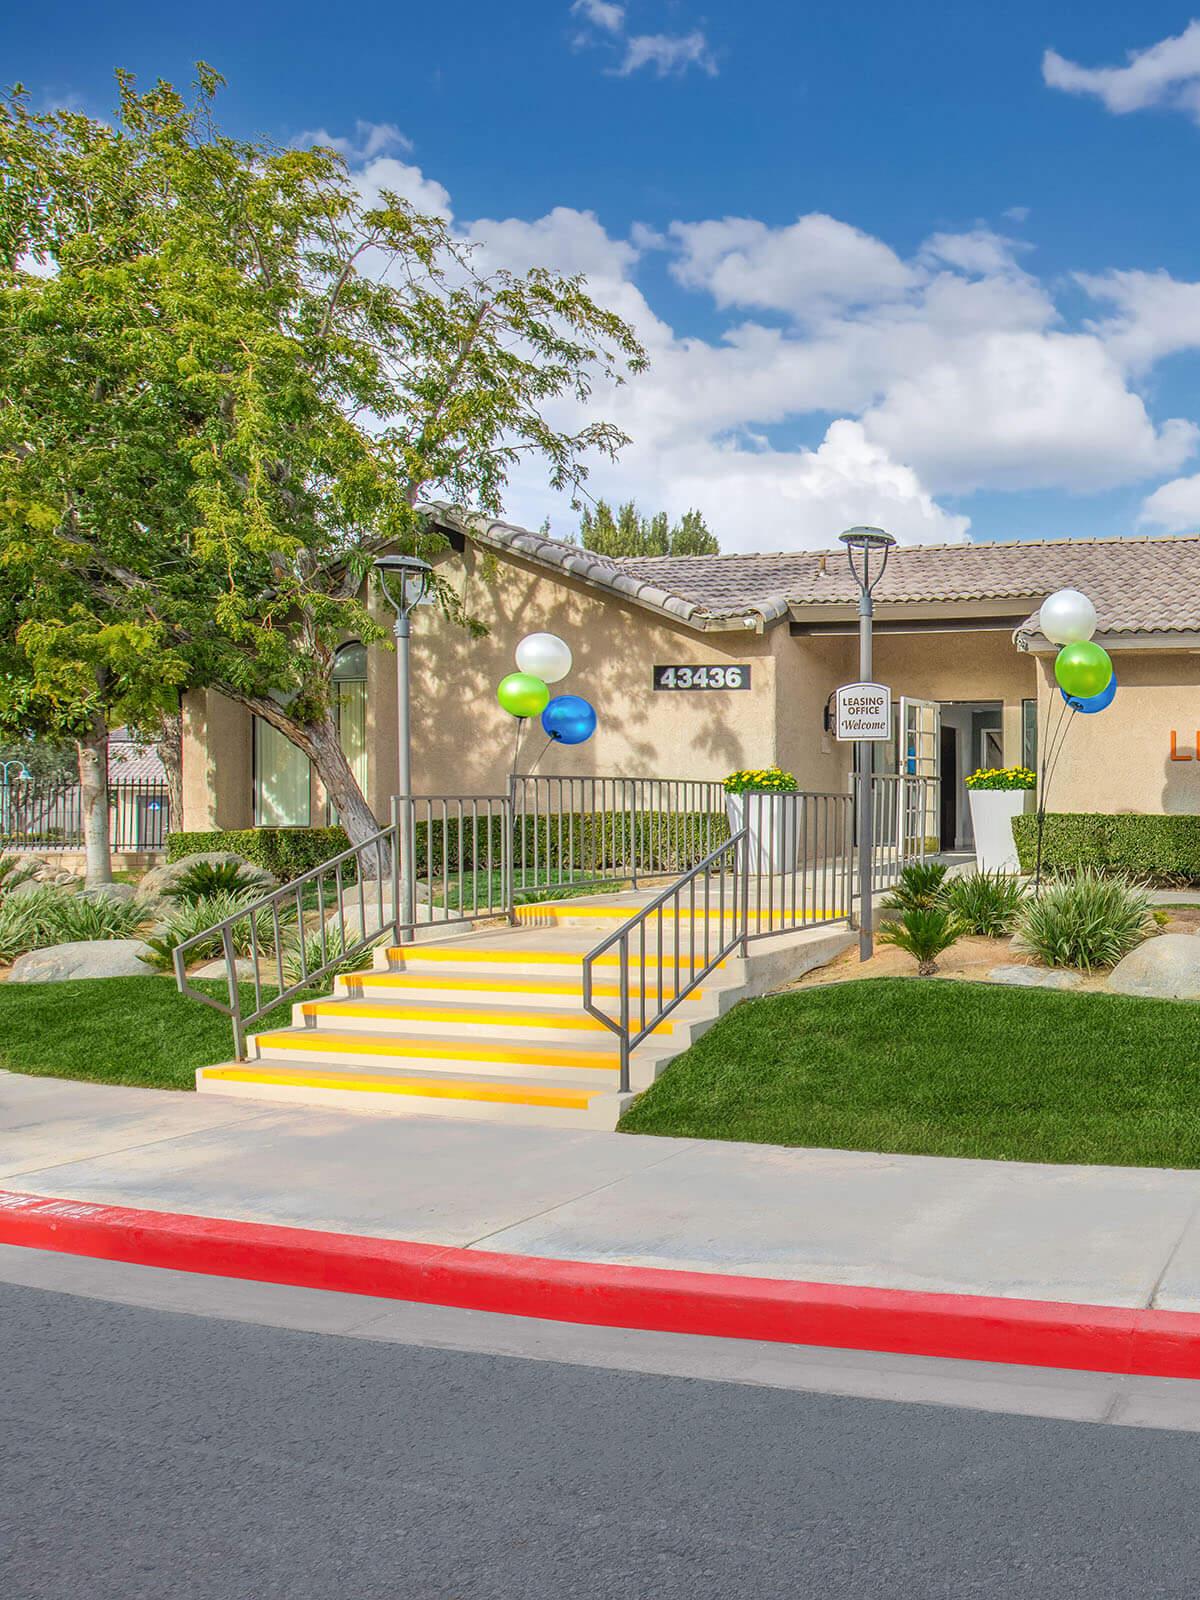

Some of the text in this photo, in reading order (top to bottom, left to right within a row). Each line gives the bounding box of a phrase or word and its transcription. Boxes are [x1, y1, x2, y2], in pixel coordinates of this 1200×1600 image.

[660, 667, 742, 688] 43436
[842, 697, 884, 706] LEASING
[847, 706, 880, 715] OFFICE
[841, 719, 886, 730] Welcome
